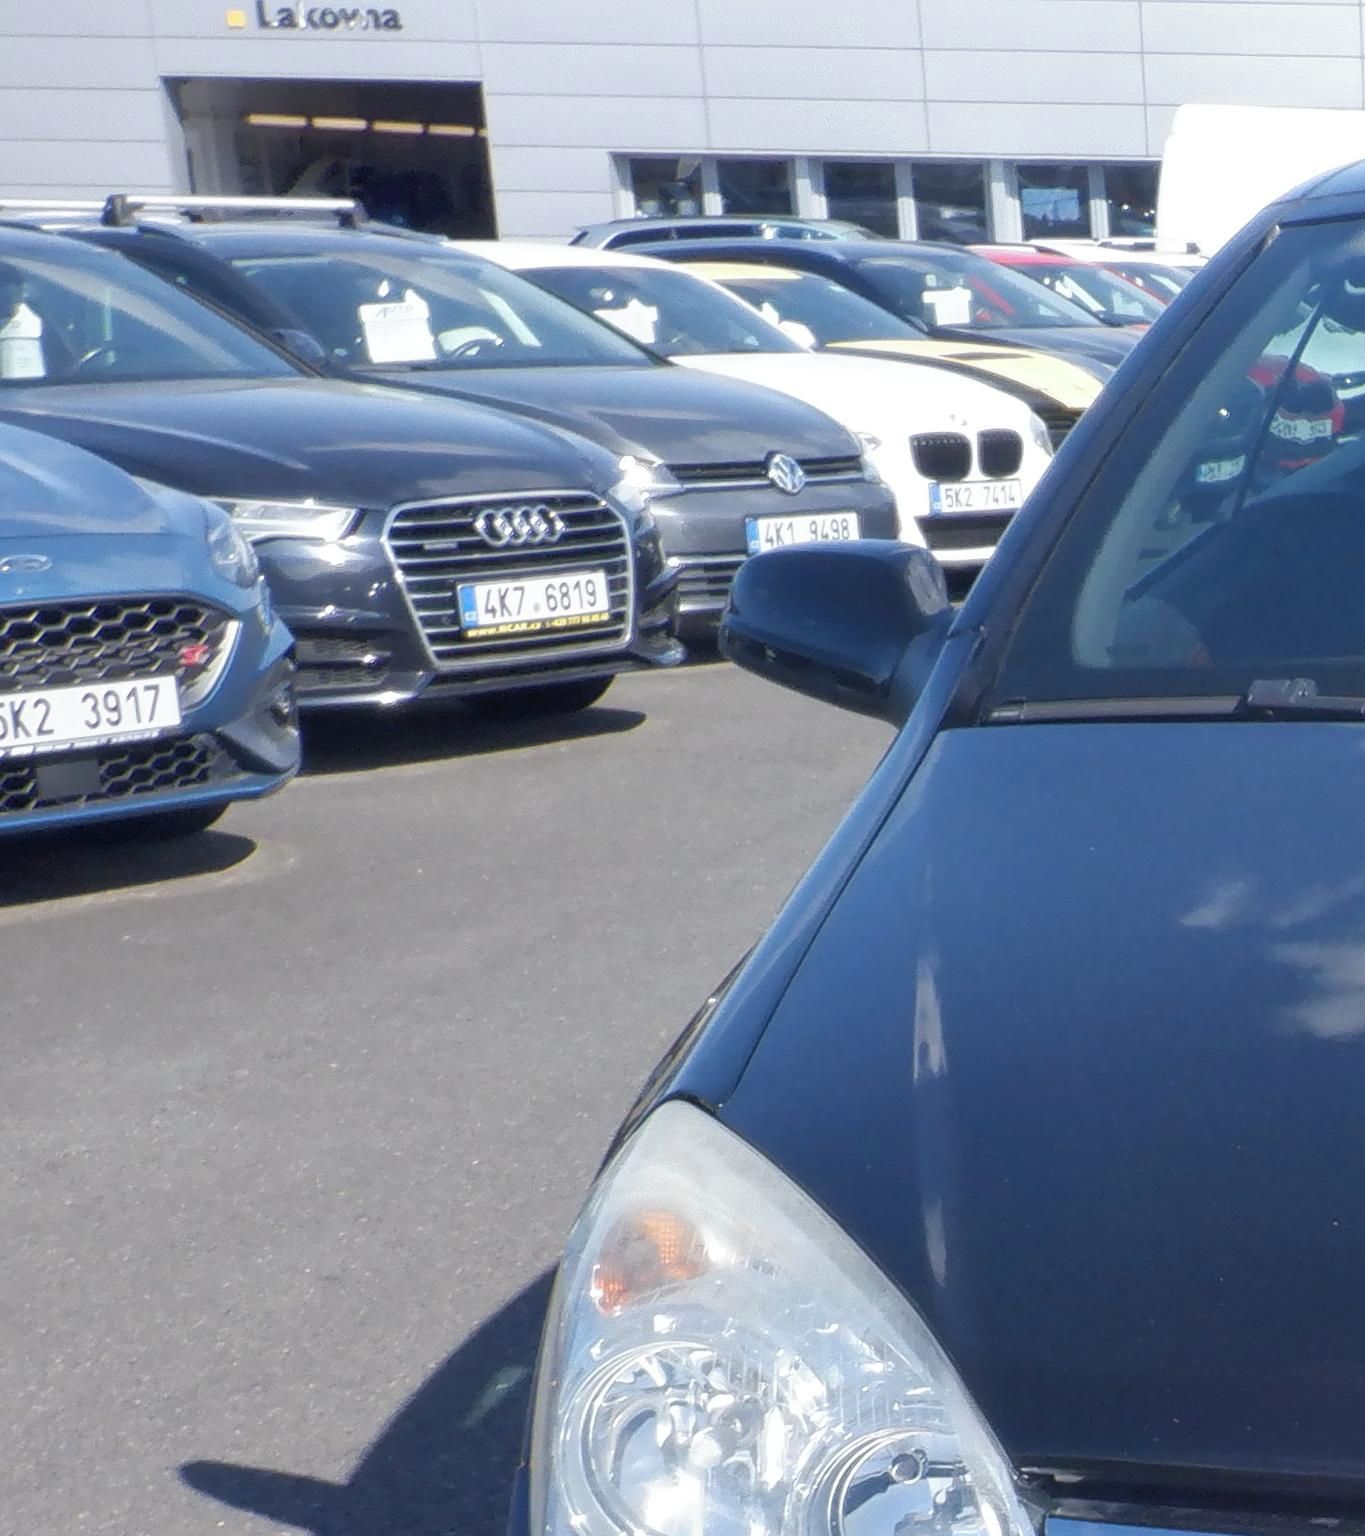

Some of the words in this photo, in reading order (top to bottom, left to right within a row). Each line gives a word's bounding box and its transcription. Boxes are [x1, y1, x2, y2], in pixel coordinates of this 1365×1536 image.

[256, 0, 403, 30] Lakovna
[945, 487, 973, 508] 5K2
[983, 484, 1016, 506] 7414
[764, 520, 796, 547] 4K1
[809, 518, 850, 541] 9498
[484, 586, 525, 618] 4K7
[545, 579, 597, 612] 6819
[81, 684, 161, 730] 3917
